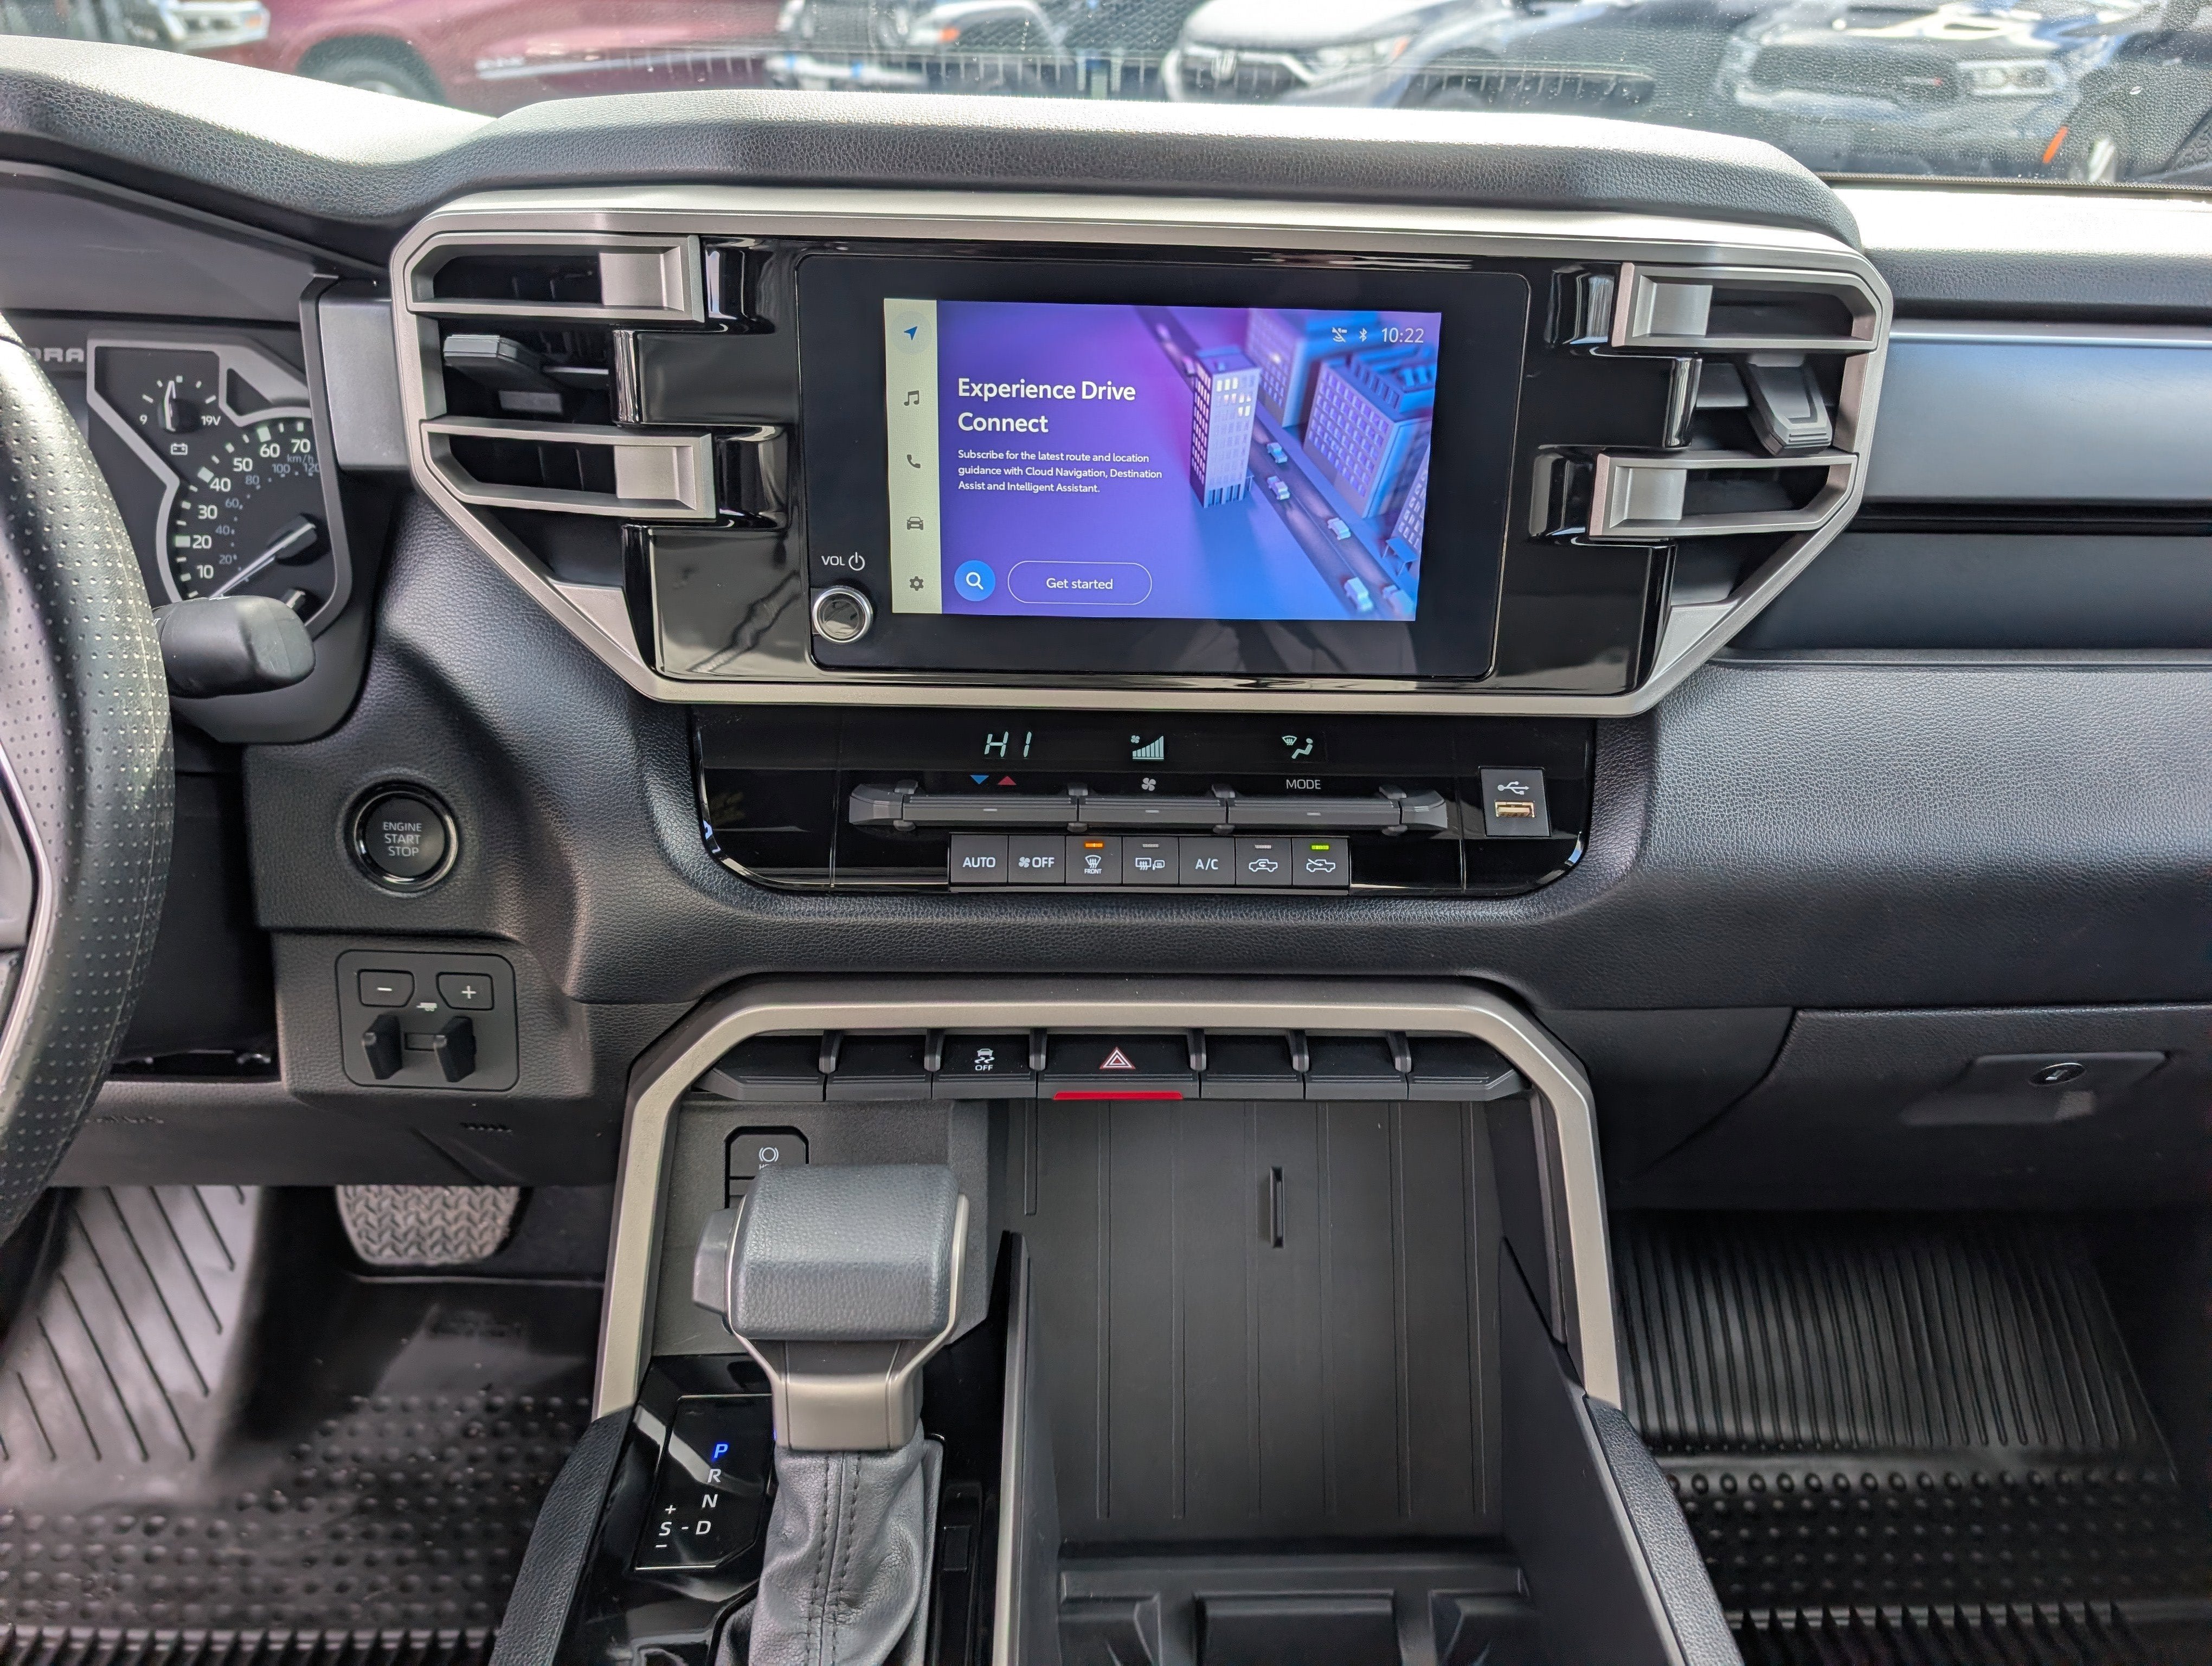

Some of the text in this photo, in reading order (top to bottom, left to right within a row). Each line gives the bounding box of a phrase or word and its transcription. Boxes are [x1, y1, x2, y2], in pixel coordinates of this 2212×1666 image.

[1382, 328, 1424, 343] 10:22
[959, 378, 1135, 401] Experience Drive
[140, 415, 147, 425] 9
[201, 415, 221, 425] 19V
[959, 412, 1049, 432] Connect
[260, 444, 280, 457] 60
[292, 439, 310, 452] 70
[287, 454, 314, 463] km/h
[958, 450, 1149, 462] Subscribe for the latest route and location
[234, 458, 252, 471] 50
[273, 464, 290, 473] 100
[958, 465, 1162, 478] guidance with Cloud Navigation, Destination
[210, 478, 231, 491] 40
[246, 476, 259, 484] 80
[958, 480, 1100, 493] Assist and Intelligent Assistant.
[226, 498, 239, 508] 60
[199, 505, 217, 518] 30
[216, 525, 229, 534] 40
[193, 535, 211, 548] 20
[220, 554, 232, 565] 20
[821, 556, 845, 566] VOL
[197, 565, 214, 578] 10
[1046, 578, 1113, 589] Get started
[985, 732, 1031, 757] HI
[1287, 779, 1321, 789] MODE
[384, 822, 421, 831] ENGINE
[384, 834, 421, 844] START
[388, 846, 419, 857] STOP
[963, 857, 995, 867] AUTO
[1032, 857, 1054, 867] OFF
[1195, 858, 1218, 870] A/C
[714, 1444, 728, 1458] P
[707, 1469, 721, 1483] R
[702, 1494, 718, 1508] N
[659, 1522, 672, 1535] S
[696, 1521, 711, 1535] D
